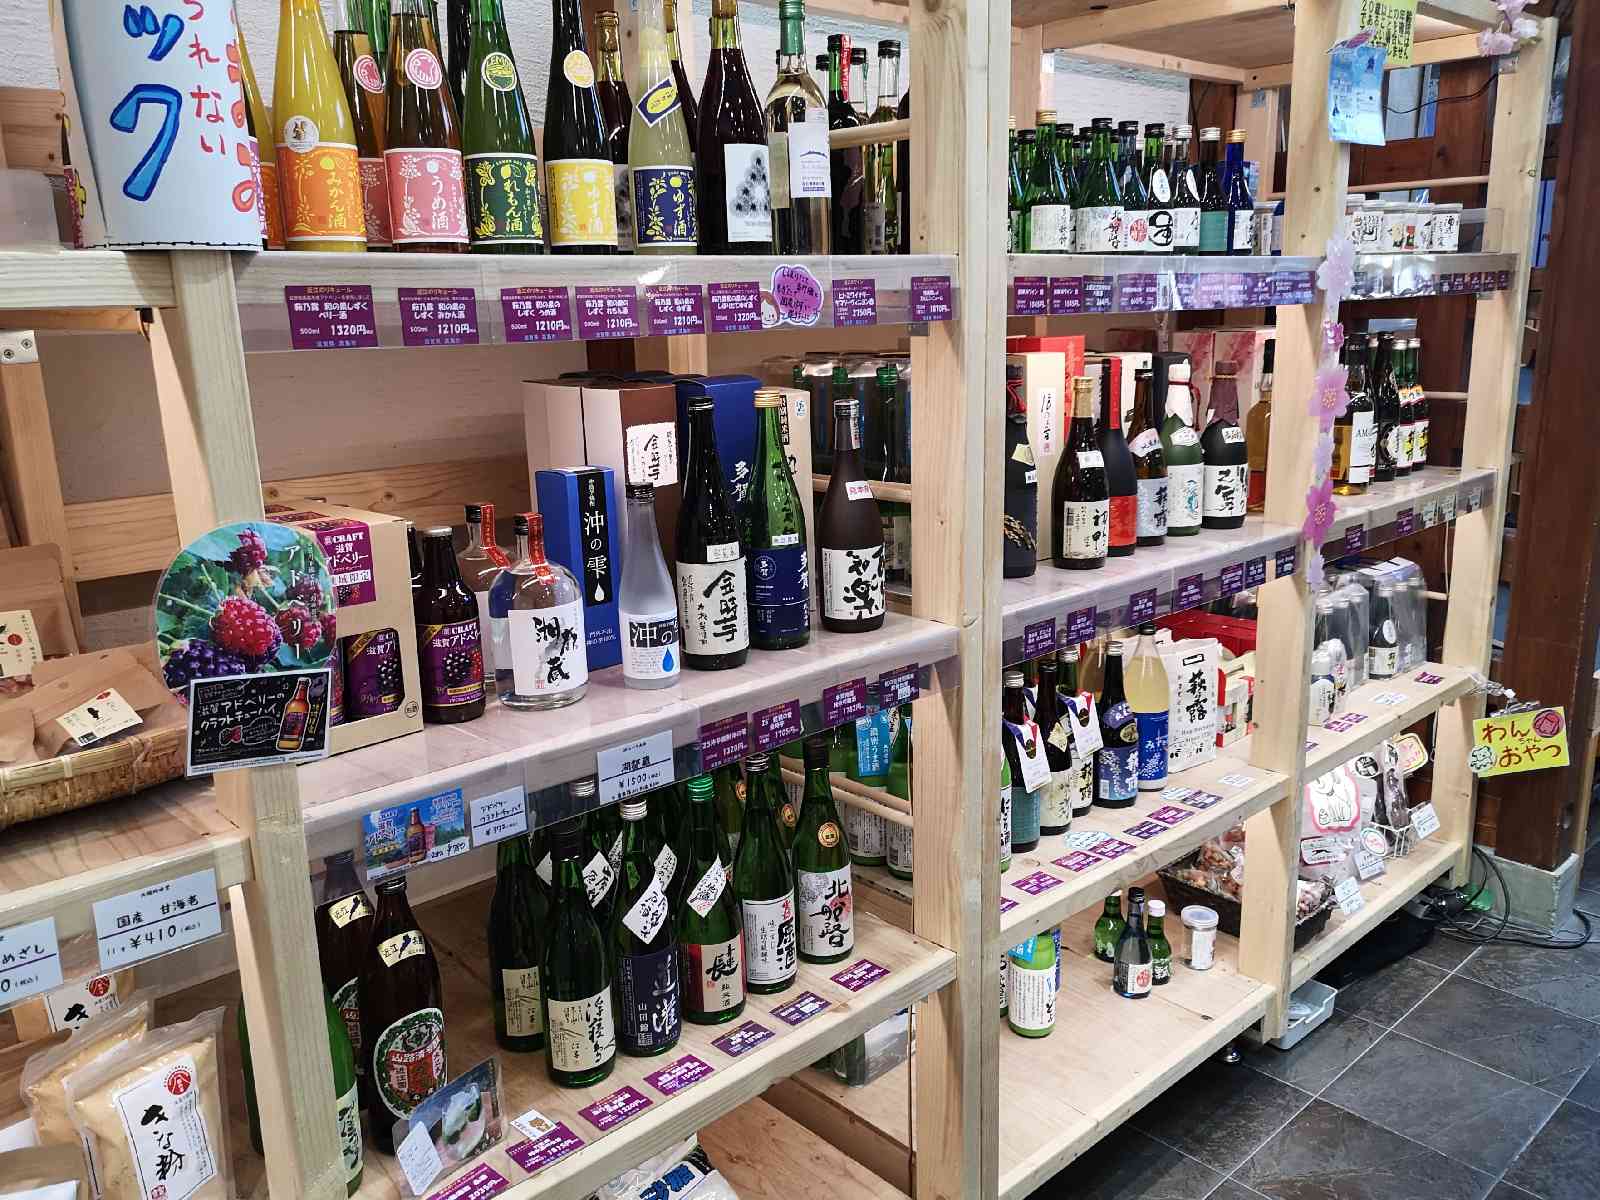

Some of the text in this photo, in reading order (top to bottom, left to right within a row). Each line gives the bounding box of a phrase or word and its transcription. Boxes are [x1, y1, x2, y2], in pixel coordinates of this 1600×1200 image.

[327, 172, 346, 229] みかん酒
[431, 176, 449, 231] うめ酒
[503, 180, 522, 233] れもん酒
[330, 324, 366, 337] 1320円
[437, 323, 471, 335] 1210円
[535, 319, 565, 332] 1210円
[332, 531, 365, 545] CRAFT
[583, 509, 609, 580] 沖の雫
[284, 545, 306, 660] アドベリー
[1482, 720, 1530, 744] わん
[1499, 743, 1562, 768] おやつ
[117, 894, 200, 929] 国産 甘海老
[814, 877, 850, 948] 北船路
[130, 924, 177, 950] ¥410
[1, 943, 45, 965] めざし
[140, 1103, 186, 1181] きな粉
